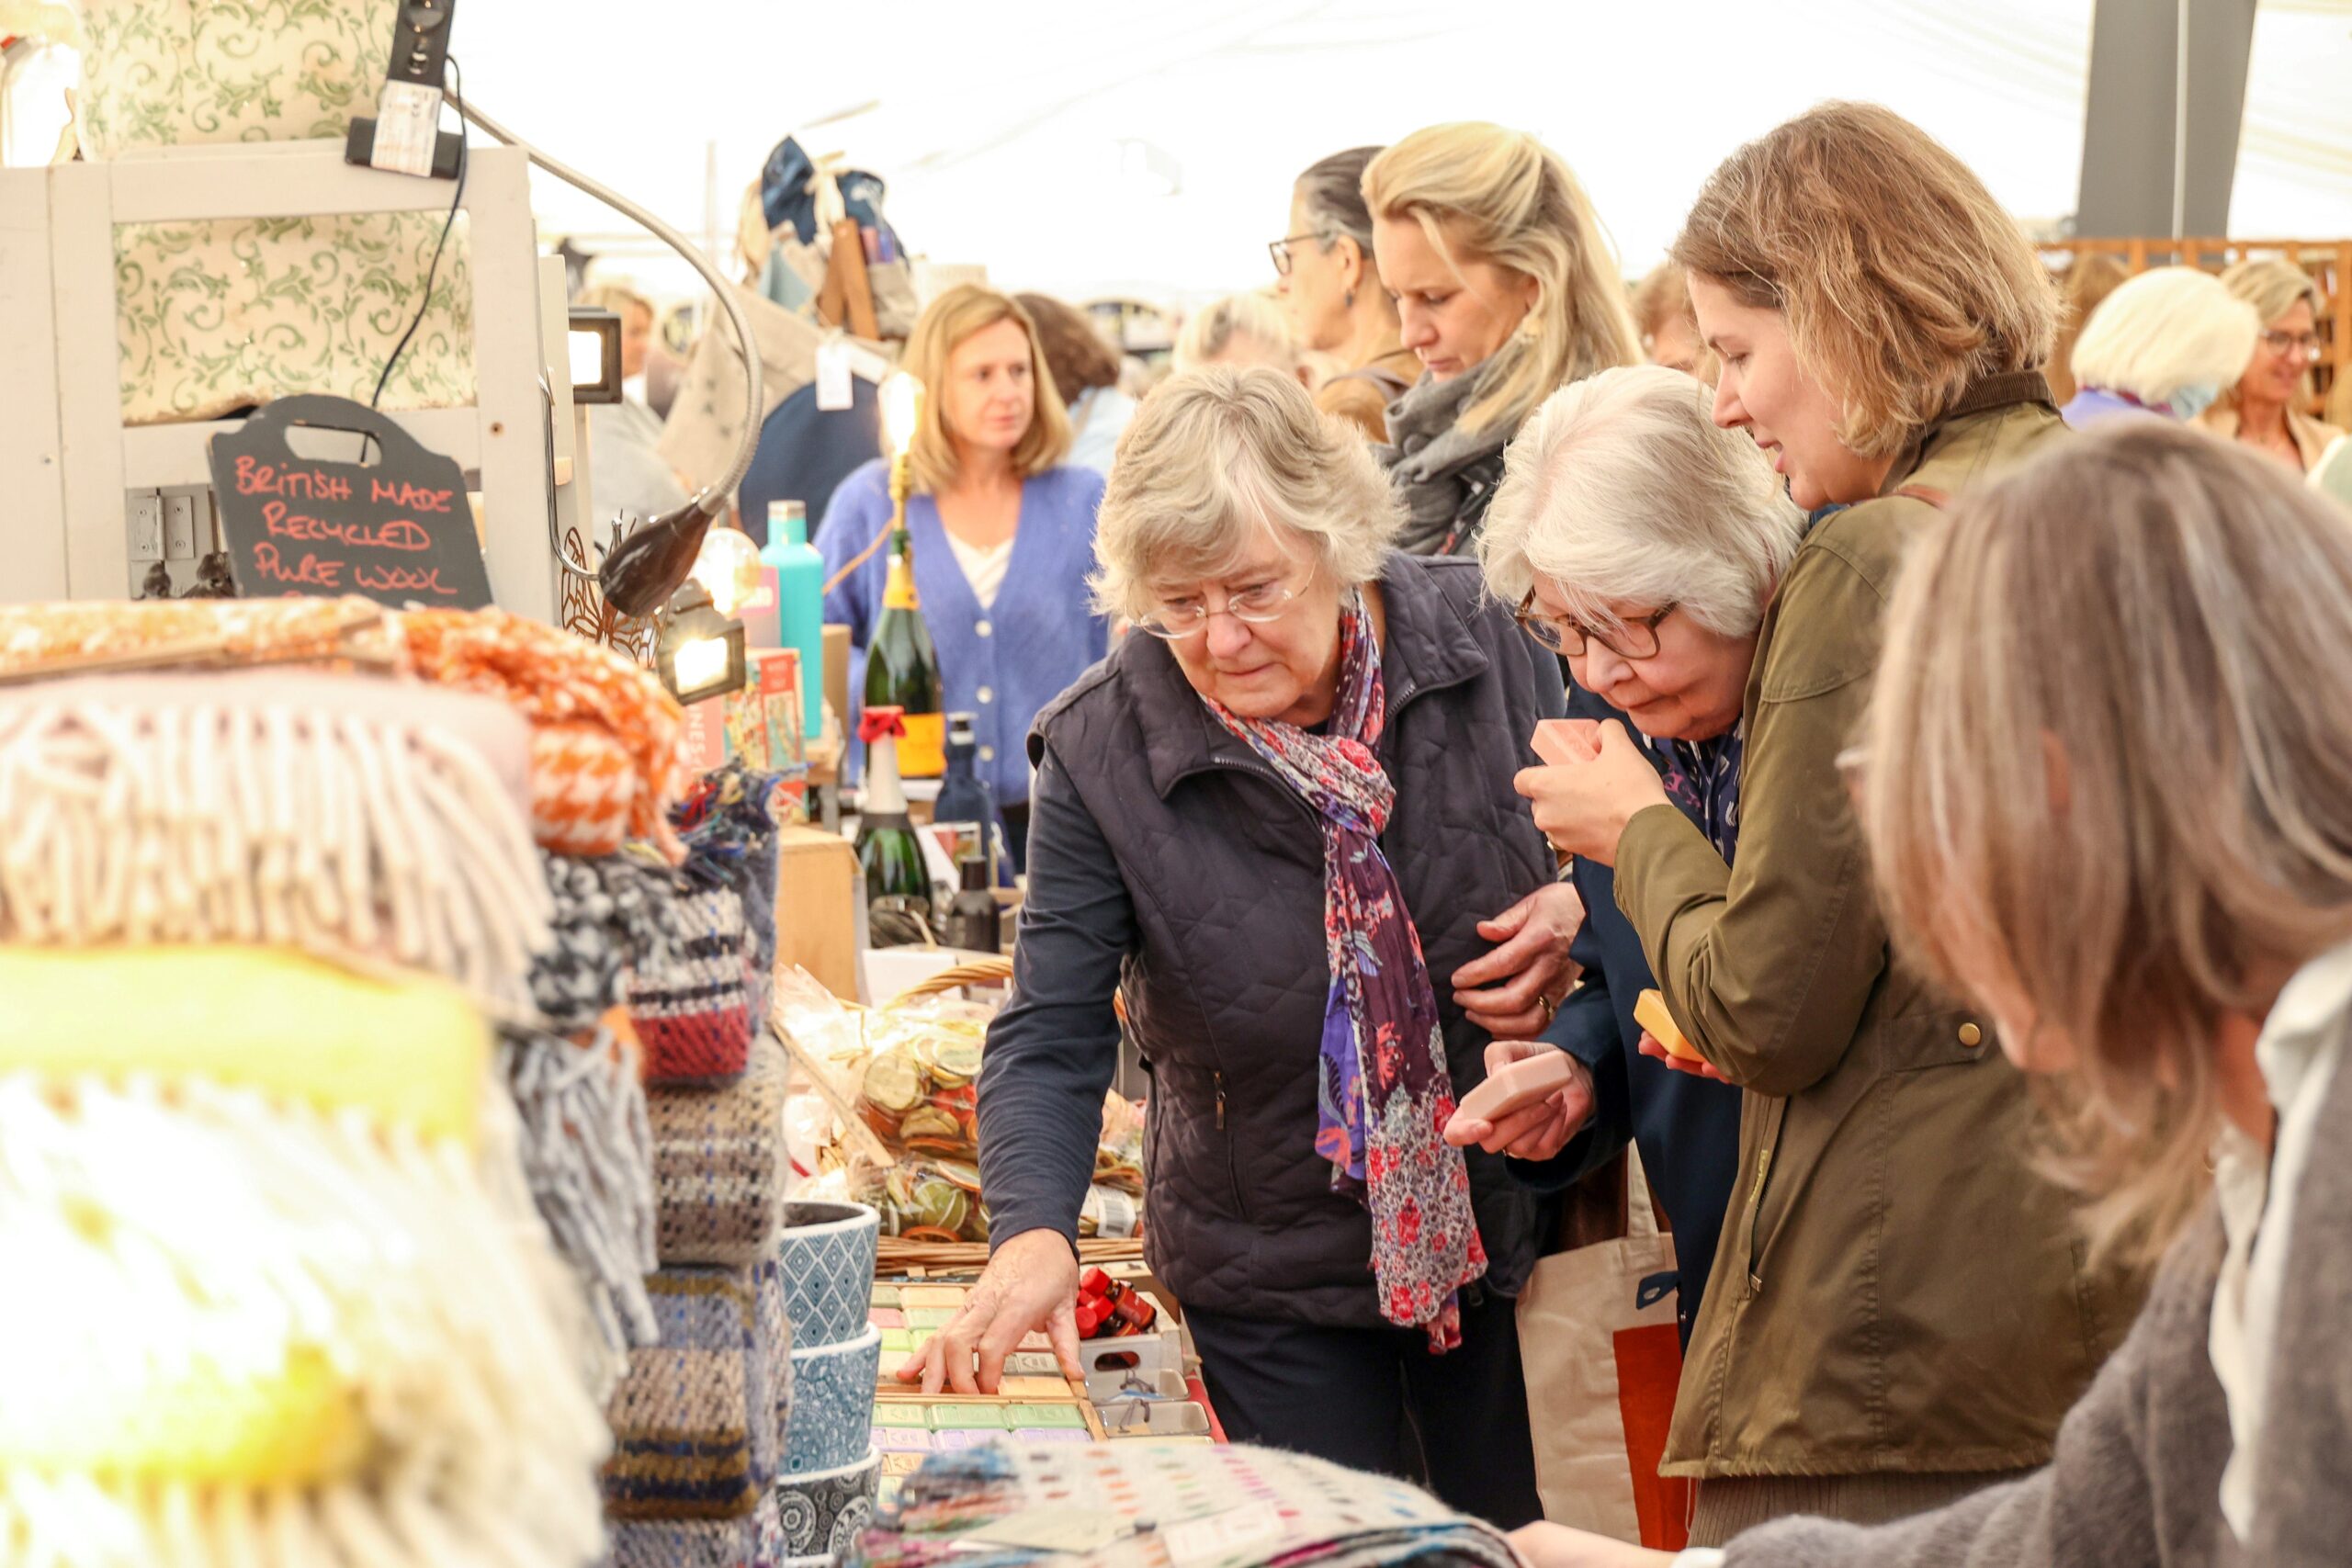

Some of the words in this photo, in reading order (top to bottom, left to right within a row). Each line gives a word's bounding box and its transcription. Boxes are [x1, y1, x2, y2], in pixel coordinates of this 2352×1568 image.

[370, 479, 454, 512] MADE
[262, 501, 431, 551] RECYCLED
[254, 542, 345, 587] PURE
[355, 564, 458, 594] WOOL
